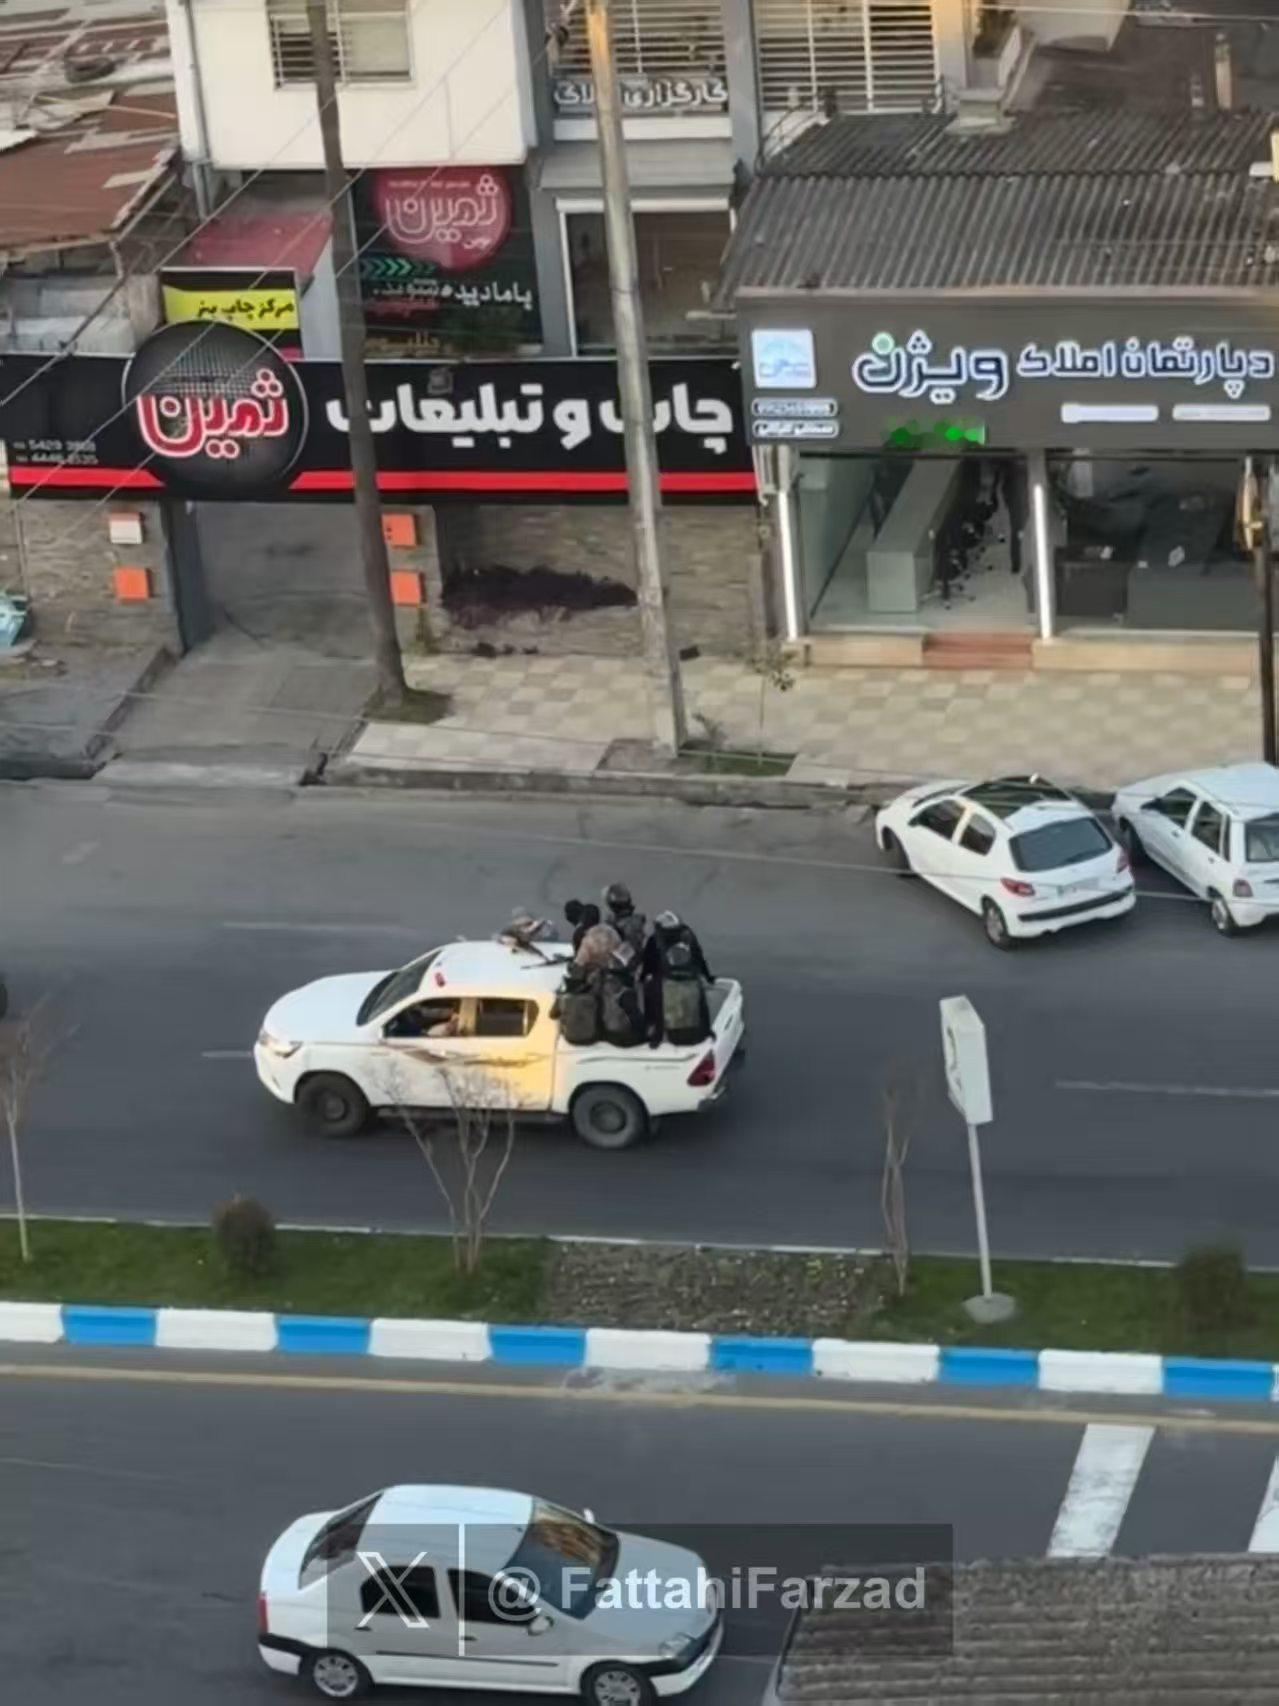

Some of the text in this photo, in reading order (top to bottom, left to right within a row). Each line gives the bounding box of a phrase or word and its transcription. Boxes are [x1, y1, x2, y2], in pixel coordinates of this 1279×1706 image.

[623, 80, 729, 107] کارگزاری
[385, 174, 500, 244] ثمین
[222, 299, 255, 320] چاپ
[258, 298, 294, 318] مرکز
[851, 328, 1275, 404] دپارتمان املاک ویژن
[136, 369, 290, 457] ثمین
[552, 396, 592, 451] و
